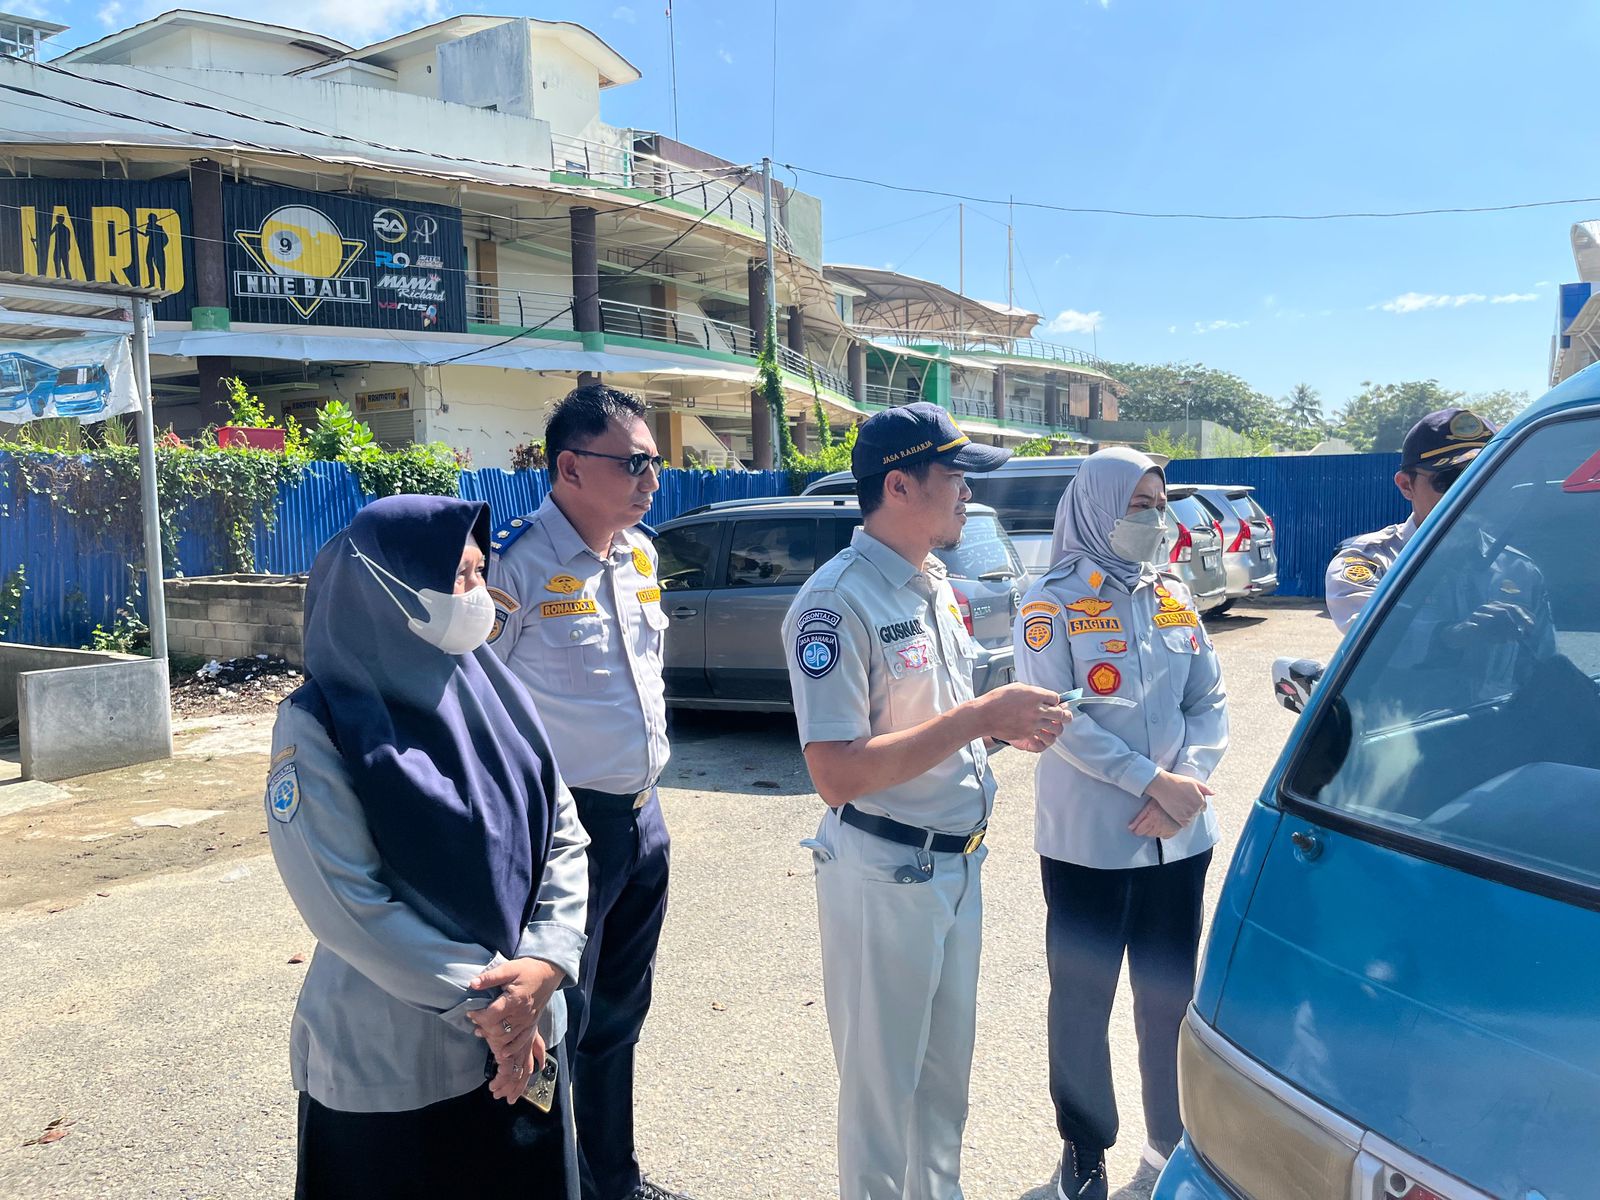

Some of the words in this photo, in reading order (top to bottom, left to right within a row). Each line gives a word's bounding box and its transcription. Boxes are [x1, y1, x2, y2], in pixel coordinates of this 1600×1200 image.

[246, 274, 296, 295] NINE
[304, 278, 360, 299] BALL
[377, 274, 439, 291] MAMA
[397, 287, 447, 302] Richard
[882, 453, 900, 465] JASA
[900, 440, 934, 458] RAHARJA
[1073, 619, 1119, 631] SAGITA
